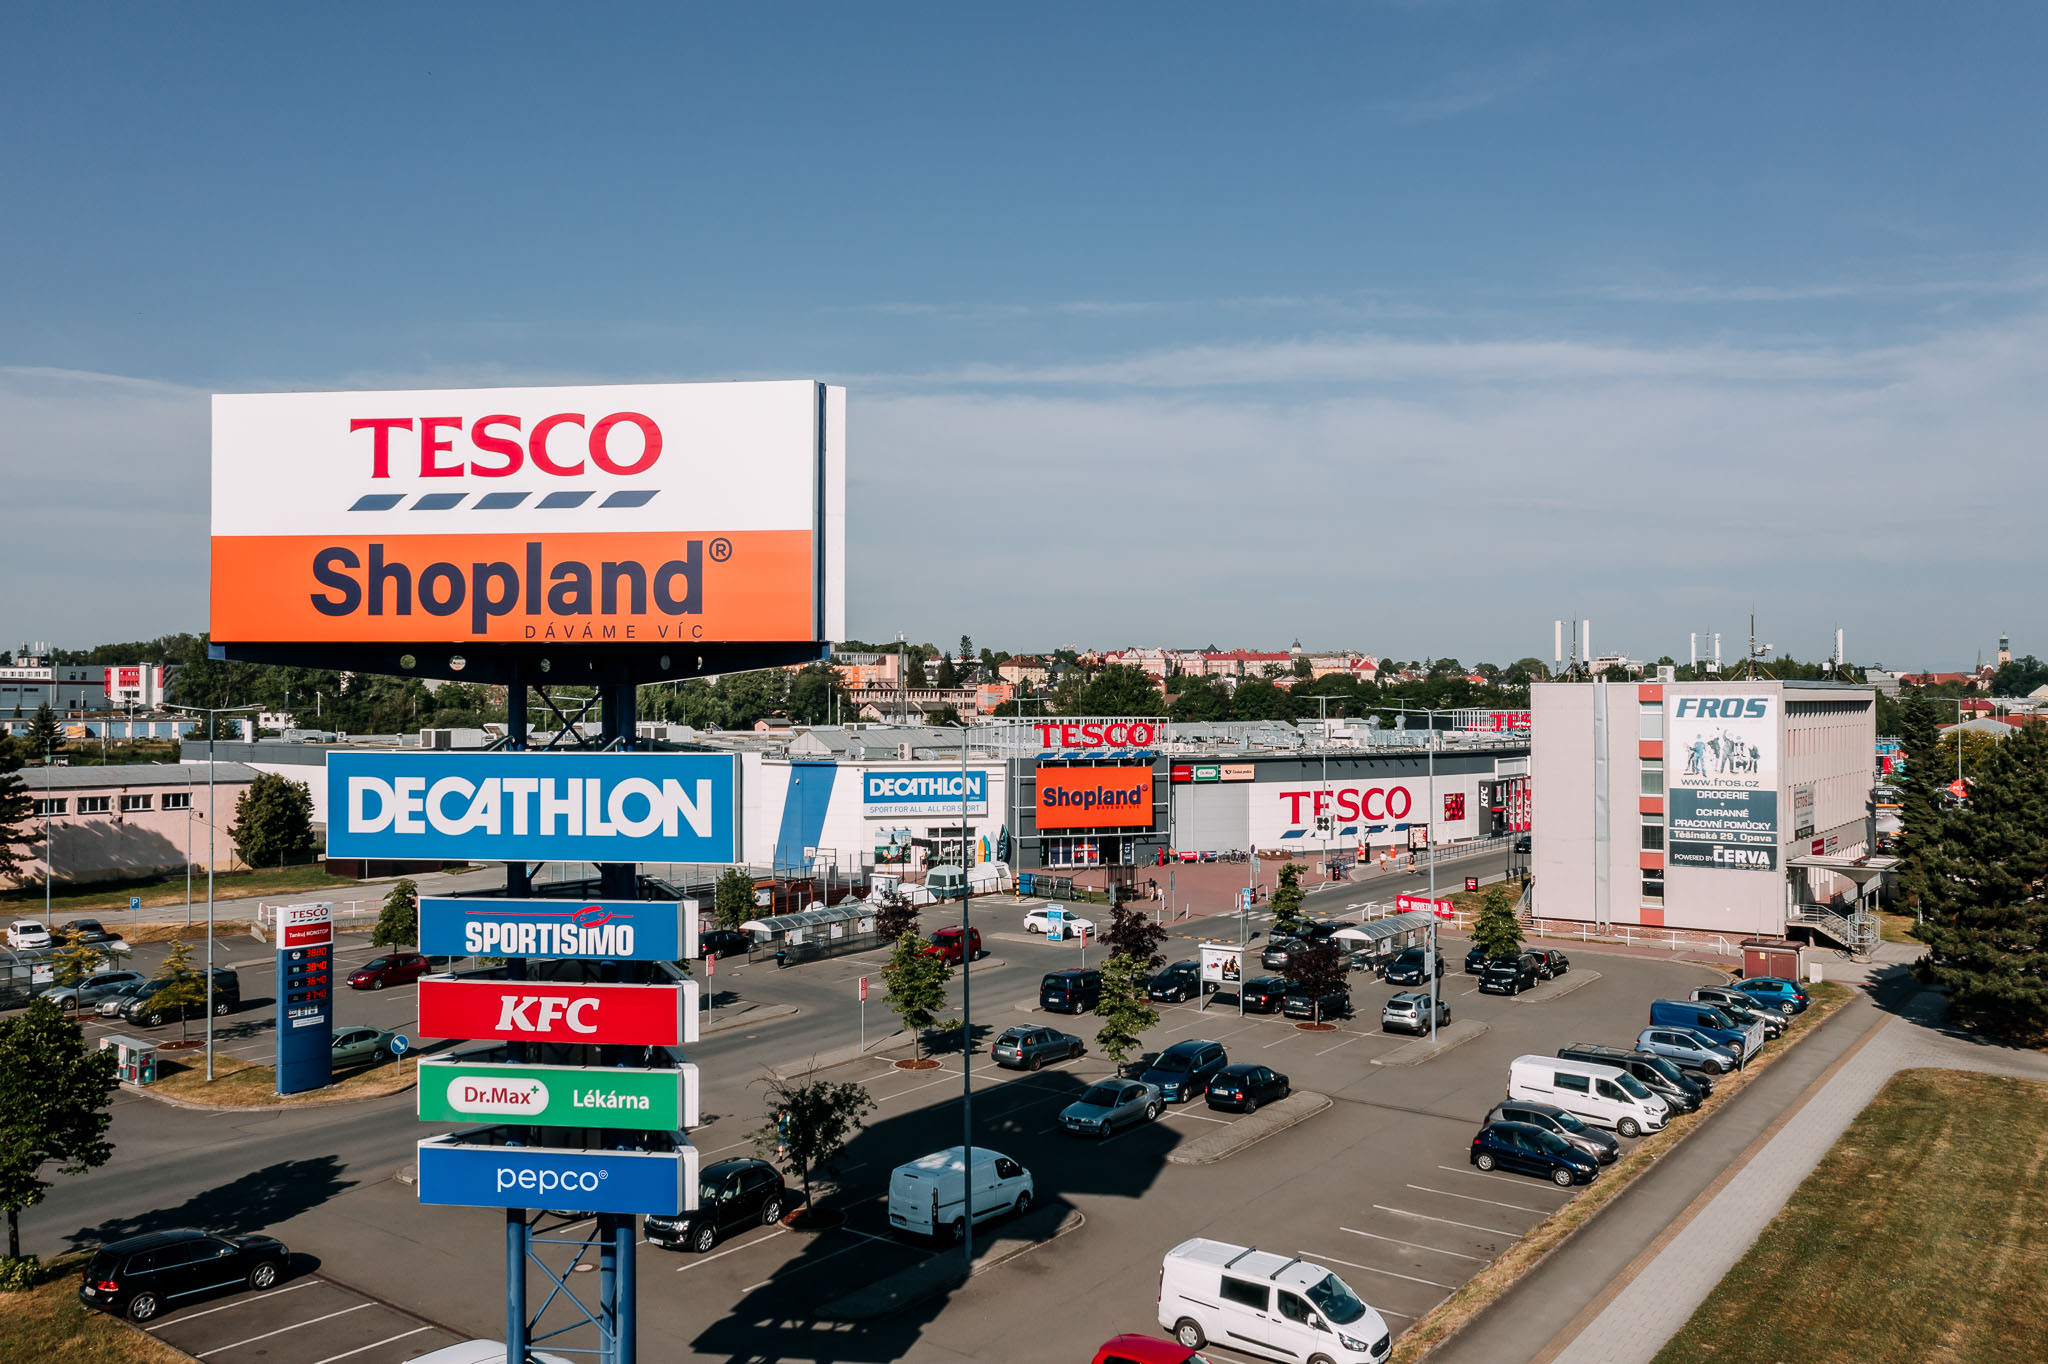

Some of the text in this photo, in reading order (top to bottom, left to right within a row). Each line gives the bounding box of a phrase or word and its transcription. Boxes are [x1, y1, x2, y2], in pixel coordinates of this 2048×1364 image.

[350, 411, 663, 478] TESCO
[525, 621, 703, 639] DÁVÁME VÍC
[1675, 698, 1769, 718] FROS
[1034, 722, 1154, 748] TESCO
[869, 777, 980, 796] DECATHLON
[1681, 777, 1760, 788] www.fros.cz
[1480, 786, 1489, 808] KFC
[1696, 790, 1750, 800] DROGERIE
[348, 776, 713, 838] DECATHLON
[910, 805, 922, 813] ALL
[942, 804, 956, 812] FOR
[1279, 786, 1412, 824] TESCO
[1696, 808, 1749, 818] OCHRANNÉ
[1674, 818, 1771, 831] PRACOVNÍ POMŮCKY
[1740, 833, 1772, 843] Opava
[1674, 853, 1704, 861] POWERED
[1713, 845, 1771, 865] ČERVA
[132, 898, 138, 906] P
[290, 908, 329, 919] TESCO
[289, 928, 329, 939] Tankuj NONSTOP
[465, 921, 634, 956] SPORTISIMO
[495, 995, 600, 1034] KFC
[573, 1089, 650, 1110] Lékárna
[497, 1168, 599, 1195] pepco
